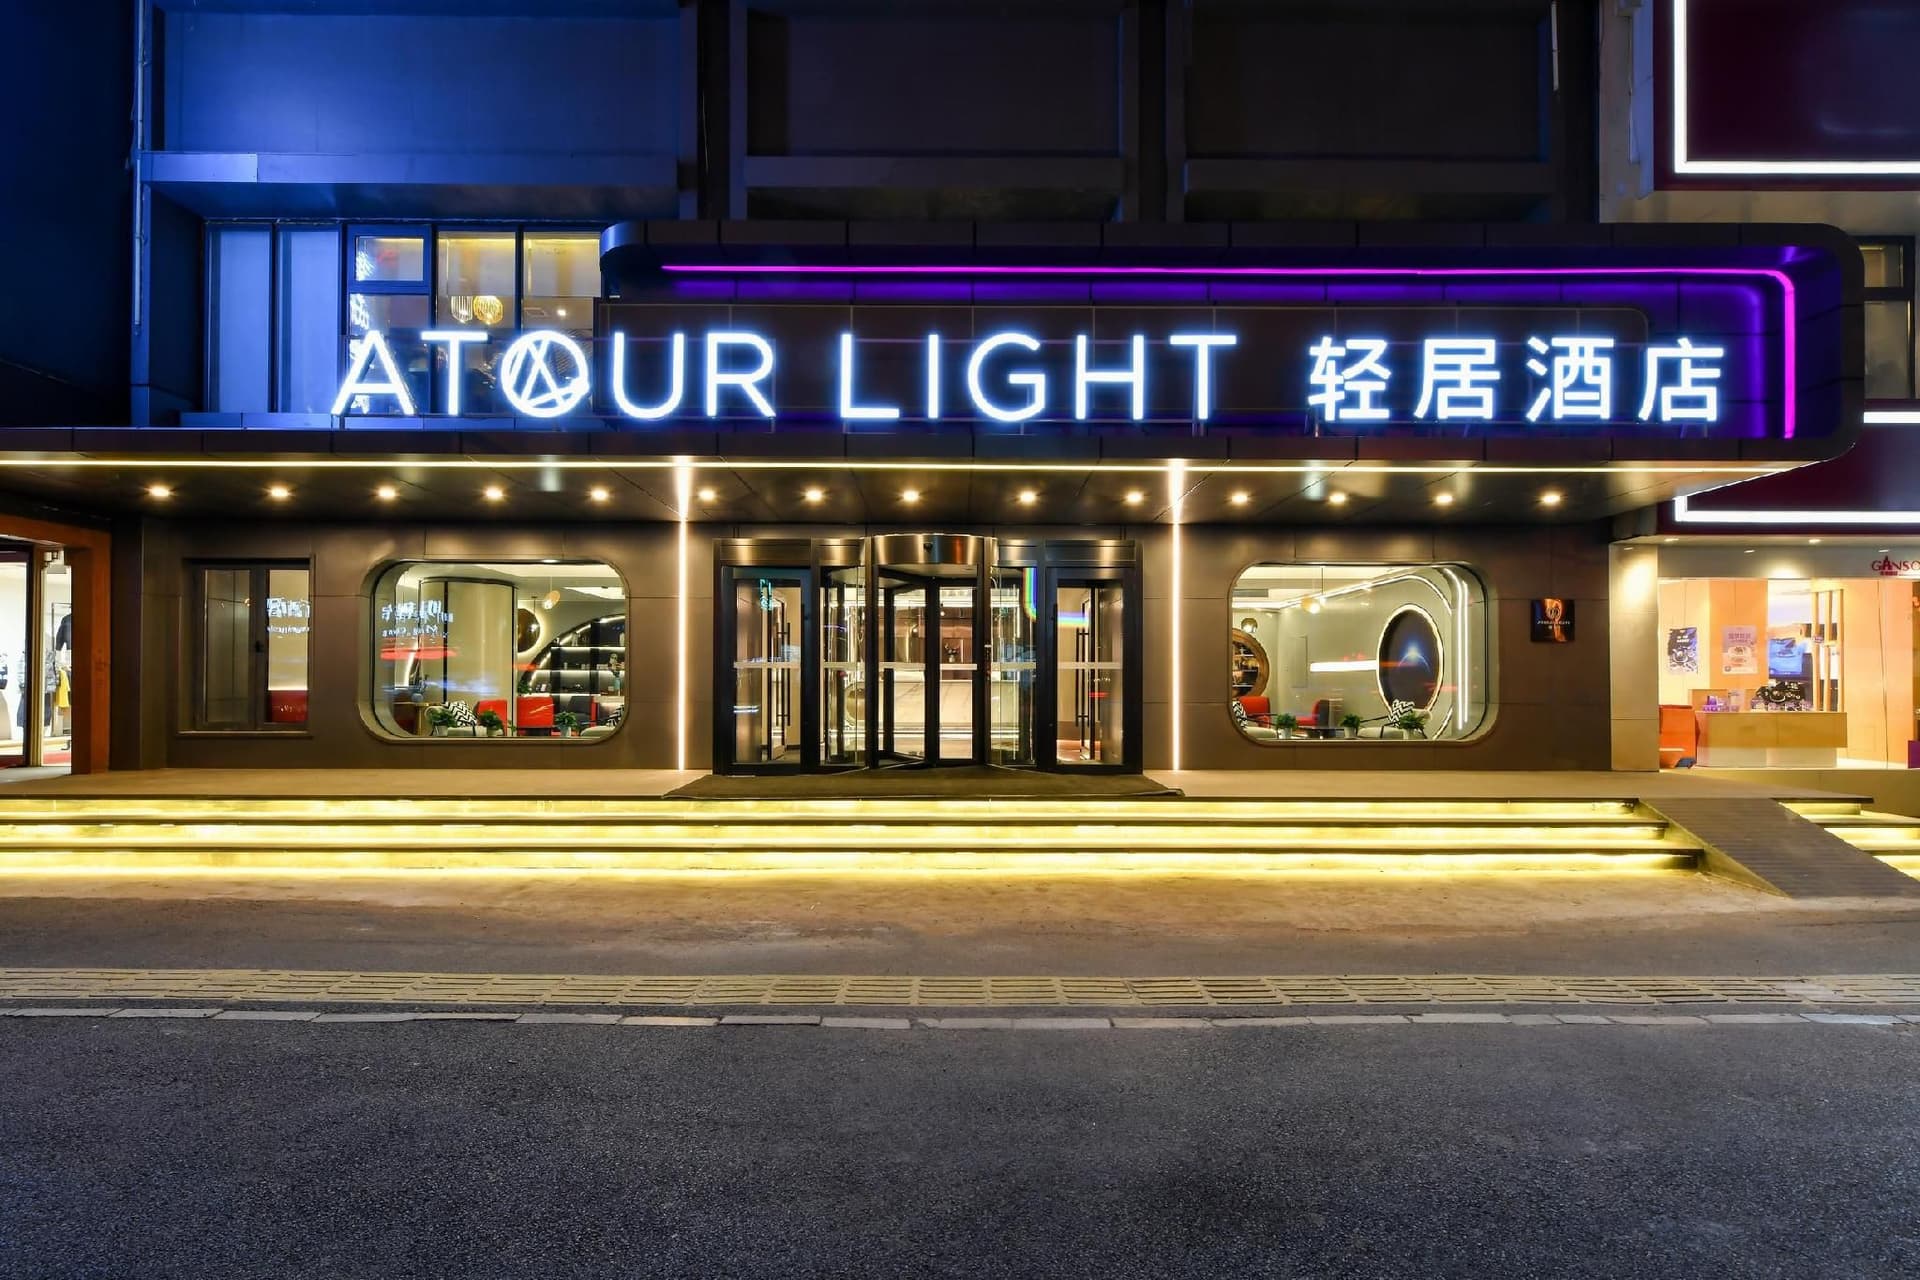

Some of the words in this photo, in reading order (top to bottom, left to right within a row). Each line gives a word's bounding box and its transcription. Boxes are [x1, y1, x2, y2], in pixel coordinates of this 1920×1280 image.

[331, 330, 777, 420] ATOUR
[840, 331, 1238, 423] LIGHT
[1307, 335, 1726, 424] 轻居酒店
